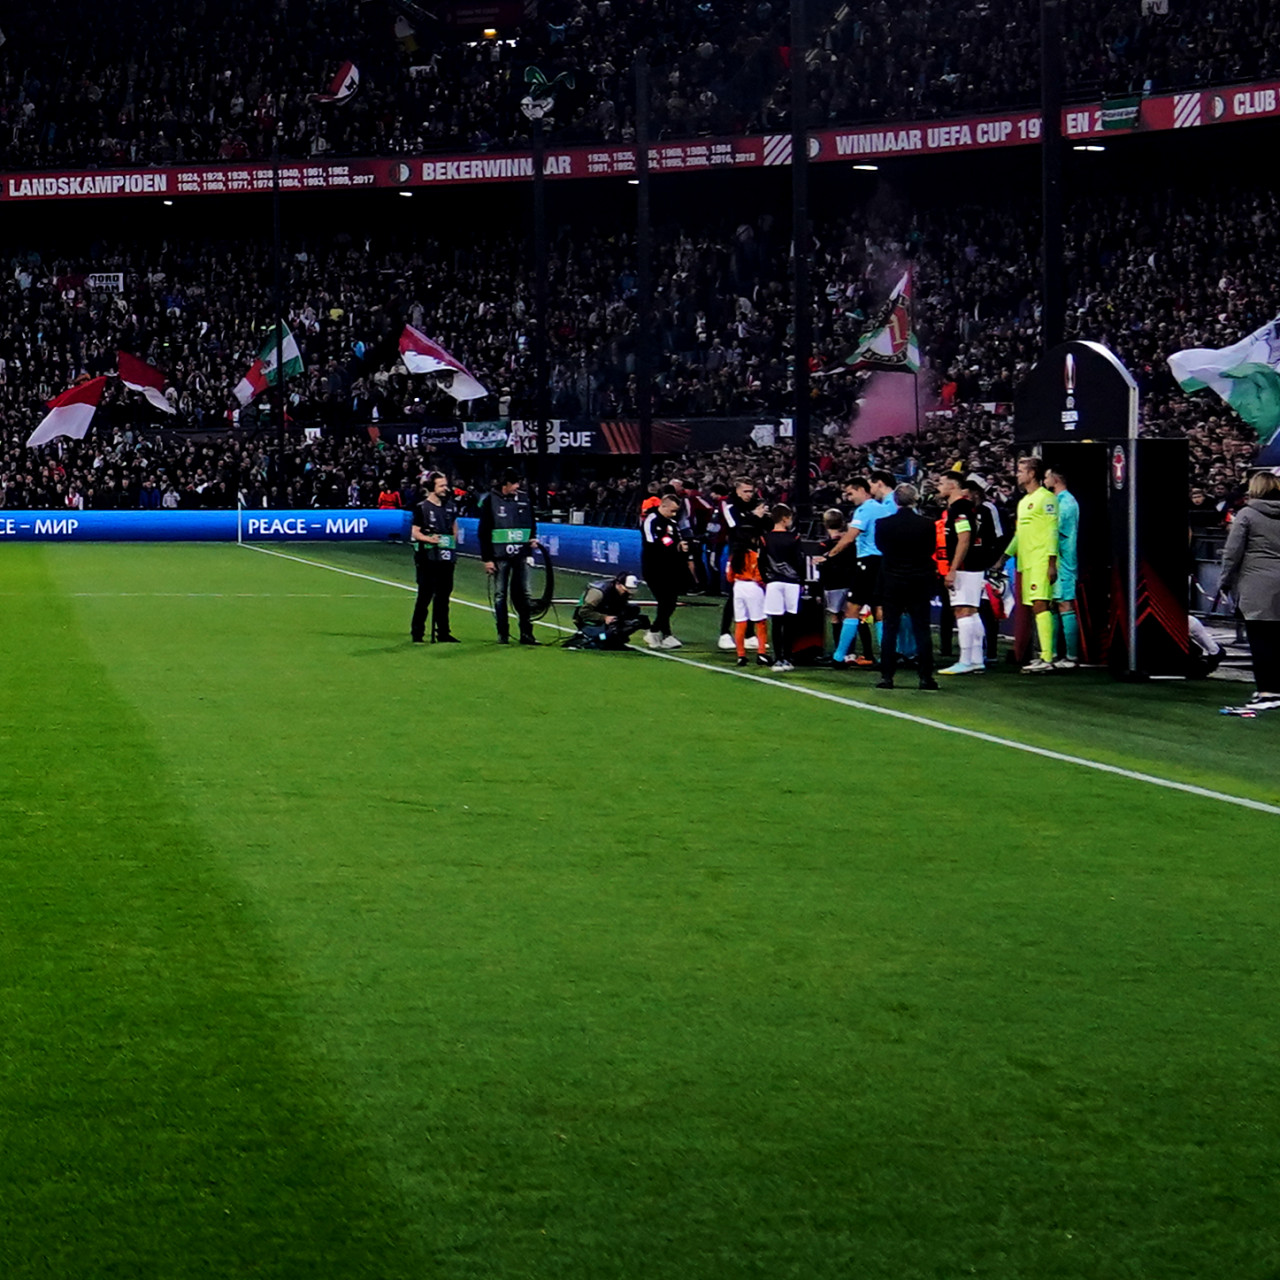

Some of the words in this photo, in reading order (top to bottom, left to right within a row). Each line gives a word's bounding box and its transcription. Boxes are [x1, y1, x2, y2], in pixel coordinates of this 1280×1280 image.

[1234, 89, 1276, 115] CLUB
[836, 131, 921, 155] WINNAAR
[927, 124, 972, 147] UEFA
[977, 121, 1012, 144] CUP
[1067, 112, 1090, 134] EN
[422, 156, 571, 180] BEKERWINNAR
[9, 174, 167, 197] LANDSKAMPIOEN
[34, 519, 78, 534] МИР
[248, 519, 306, 534] PEACE
[325, 518, 368, 534] МИР
